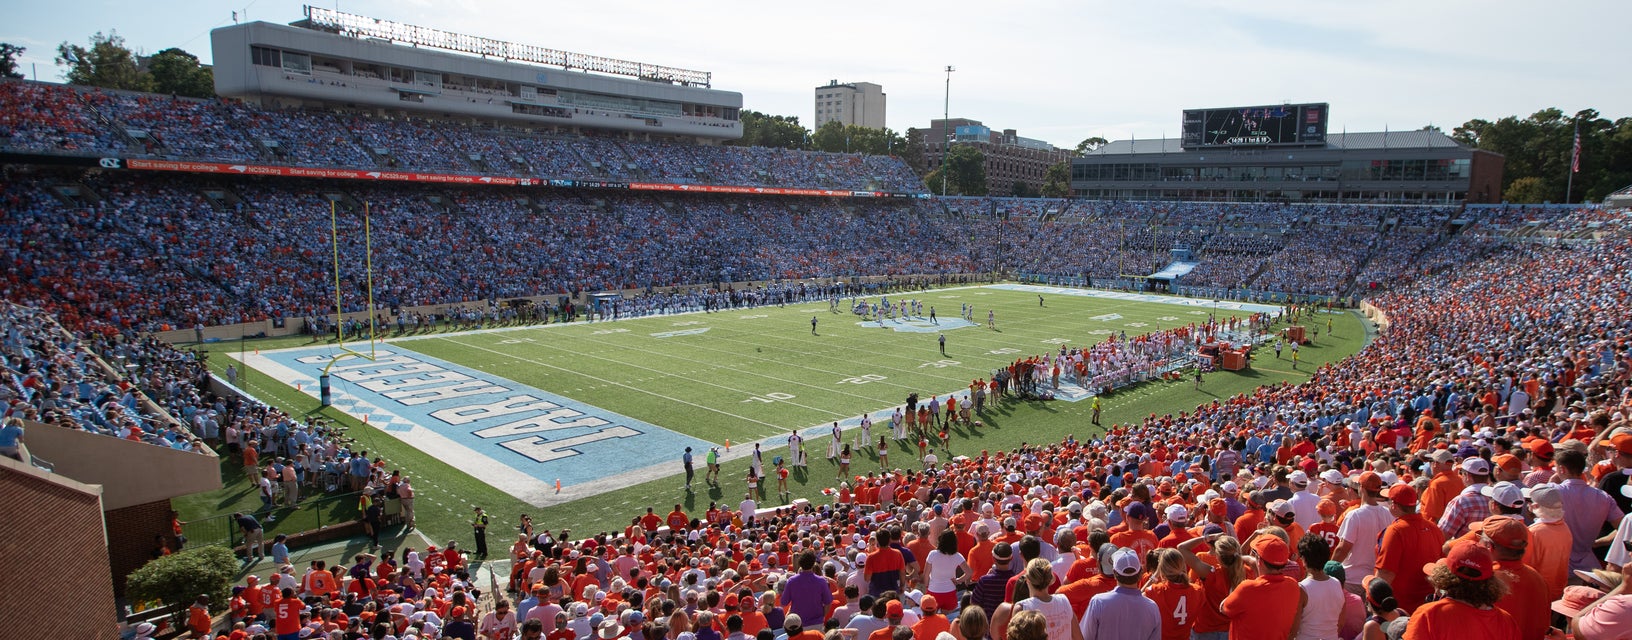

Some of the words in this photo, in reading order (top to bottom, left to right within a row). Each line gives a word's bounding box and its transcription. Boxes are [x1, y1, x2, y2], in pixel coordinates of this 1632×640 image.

[192, 164, 220, 172] college.
[846, 374, 888, 385] 20
[750, 392, 796, 403] 10
[278, 606, 288, 618] 5
[1173, 595, 1188, 625] 4
